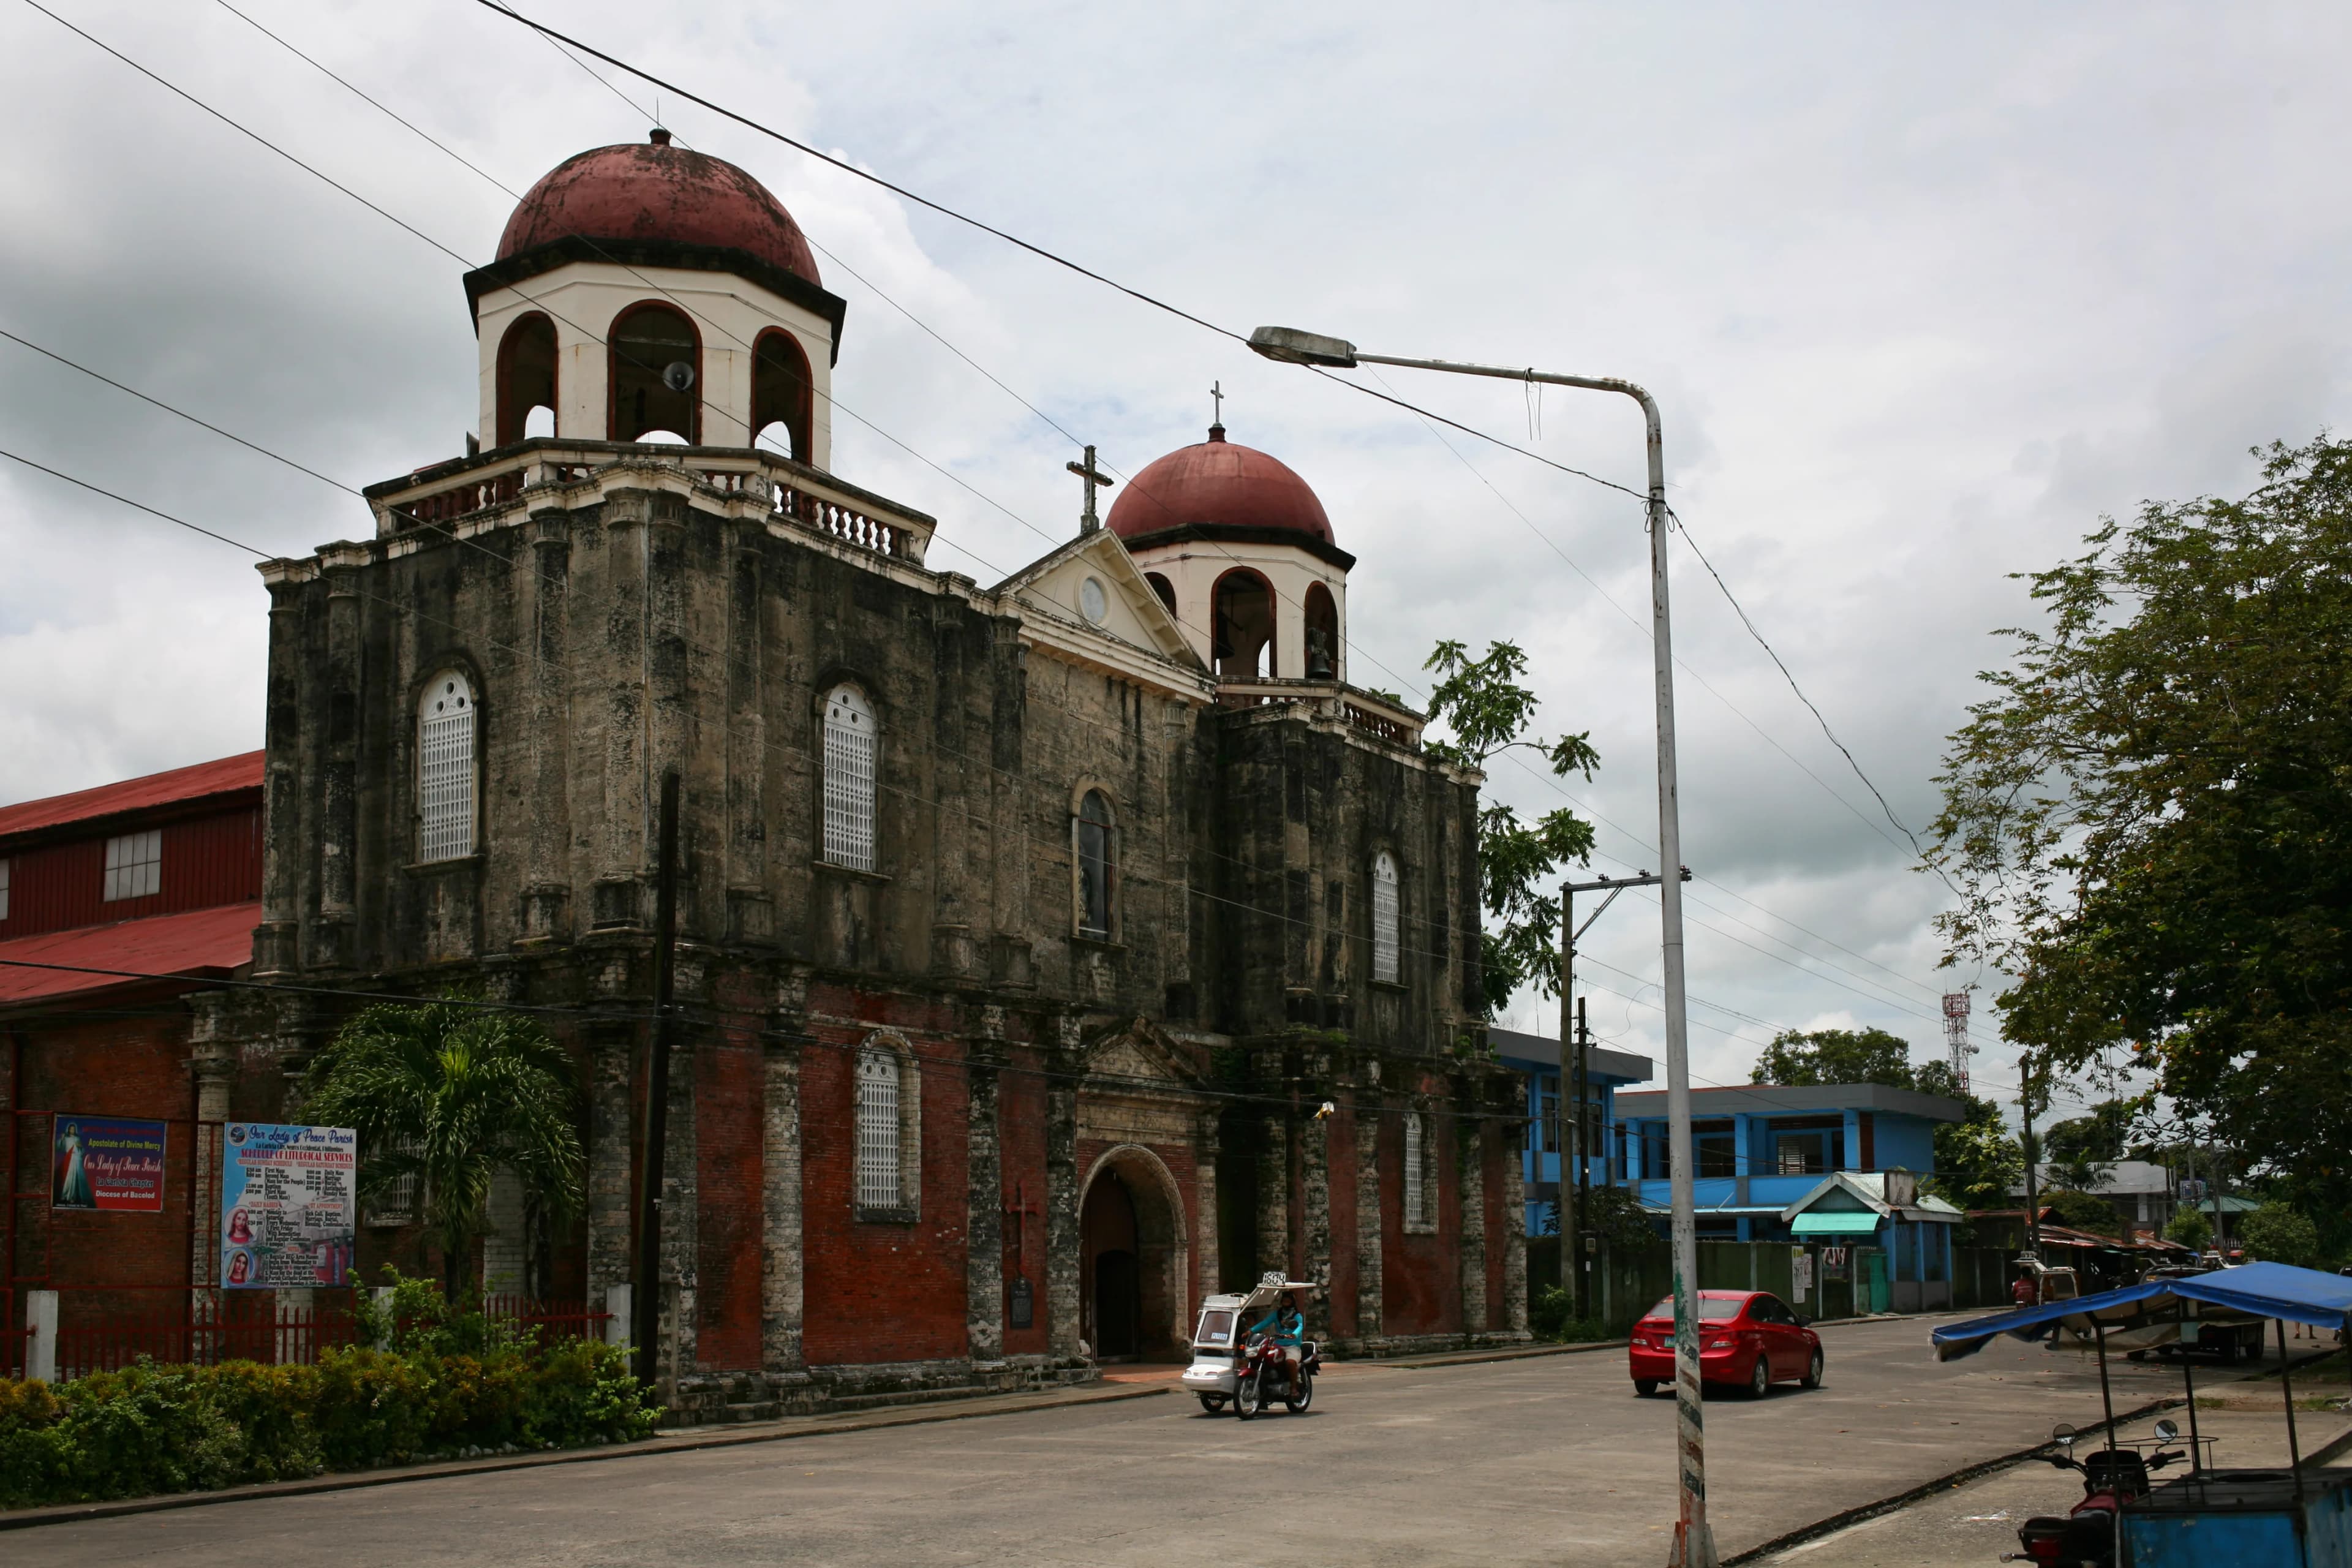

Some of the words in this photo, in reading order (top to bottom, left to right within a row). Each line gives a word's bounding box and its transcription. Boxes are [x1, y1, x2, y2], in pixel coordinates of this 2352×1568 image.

[249, 1126, 265, 1139] Our
[268, 1126, 290, 1144] Lady
[293, 1132, 302, 1144] of
[303, 1128, 325, 1142] Peace
[328, 1129, 353, 1144] Parish
[88, 1138, 118, 1148] Apostolate
[119, 1139, 126, 1148] of
[127, 1140, 143, 1149] Divine
[145, 1141, 161, 1152] Mercy
[241, 1148, 274, 1159] SCHEDULE
[275, 1150, 284, 1159] OF
[285, 1150, 322, 1161] LITURGICAL
[324, 1152, 353, 1163] SERVICES
[84, 1154, 94, 1169] Our
[97, 1154, 113, 1177] Lady
[115, 1157, 124, 1177] of
[123, 1156, 140, 1172] Peace
[141, 1156, 162, 1172] Parish
[96, 1177, 104, 1186] La
[105, 1177, 128, 1187] Carlota
[129, 1178, 154, 1189] Chapter
[96, 1190, 121, 1199] Diocese
[1264, 1274, 1284, 1284] 1604
